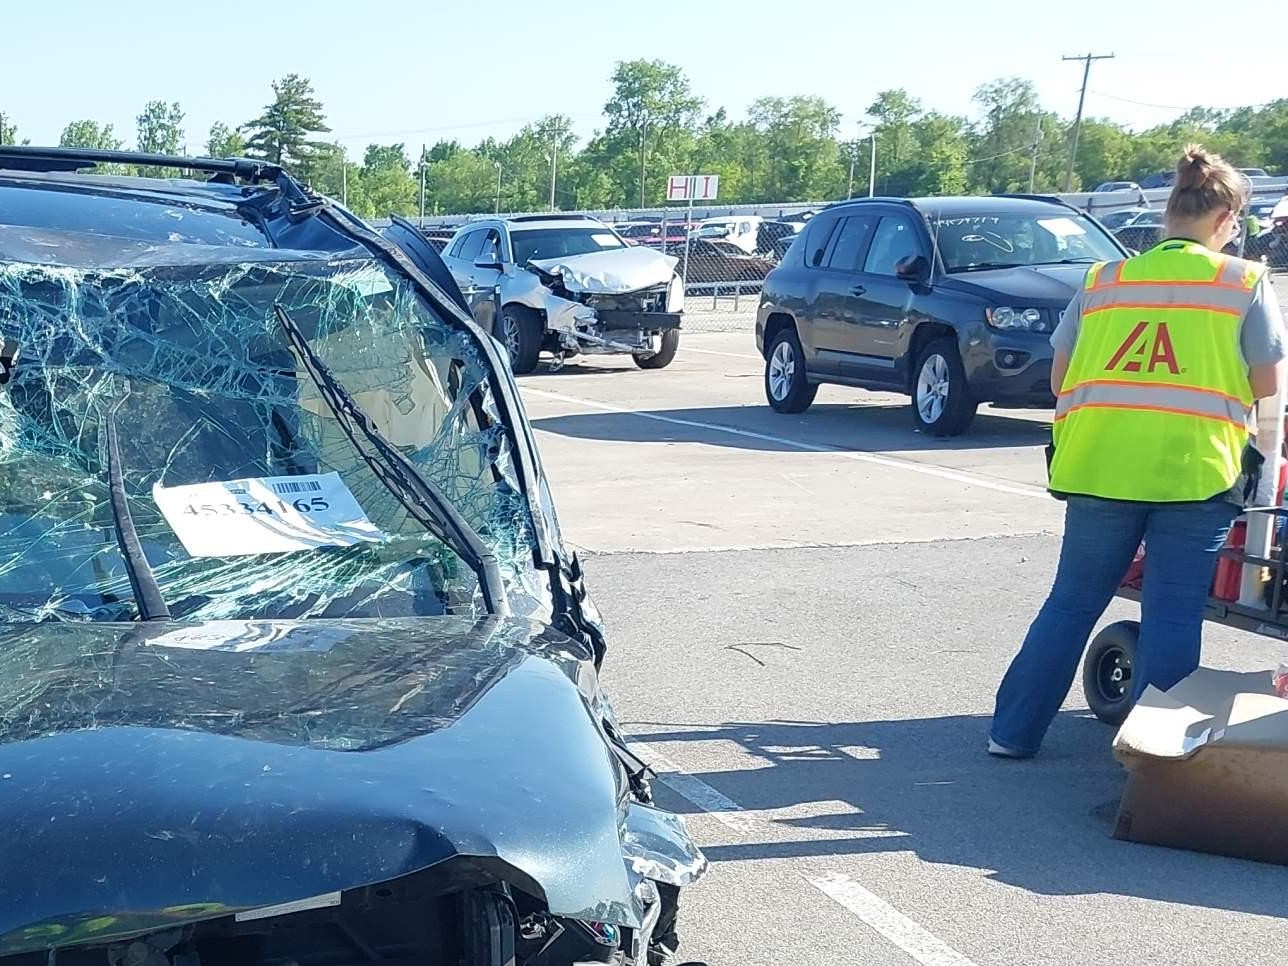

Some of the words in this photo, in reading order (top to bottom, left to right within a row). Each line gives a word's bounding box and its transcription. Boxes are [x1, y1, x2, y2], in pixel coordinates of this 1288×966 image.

[669, 177, 688, 198] H
[702, 176, 710, 198] I
[184, 497, 329, 516] 45334165
